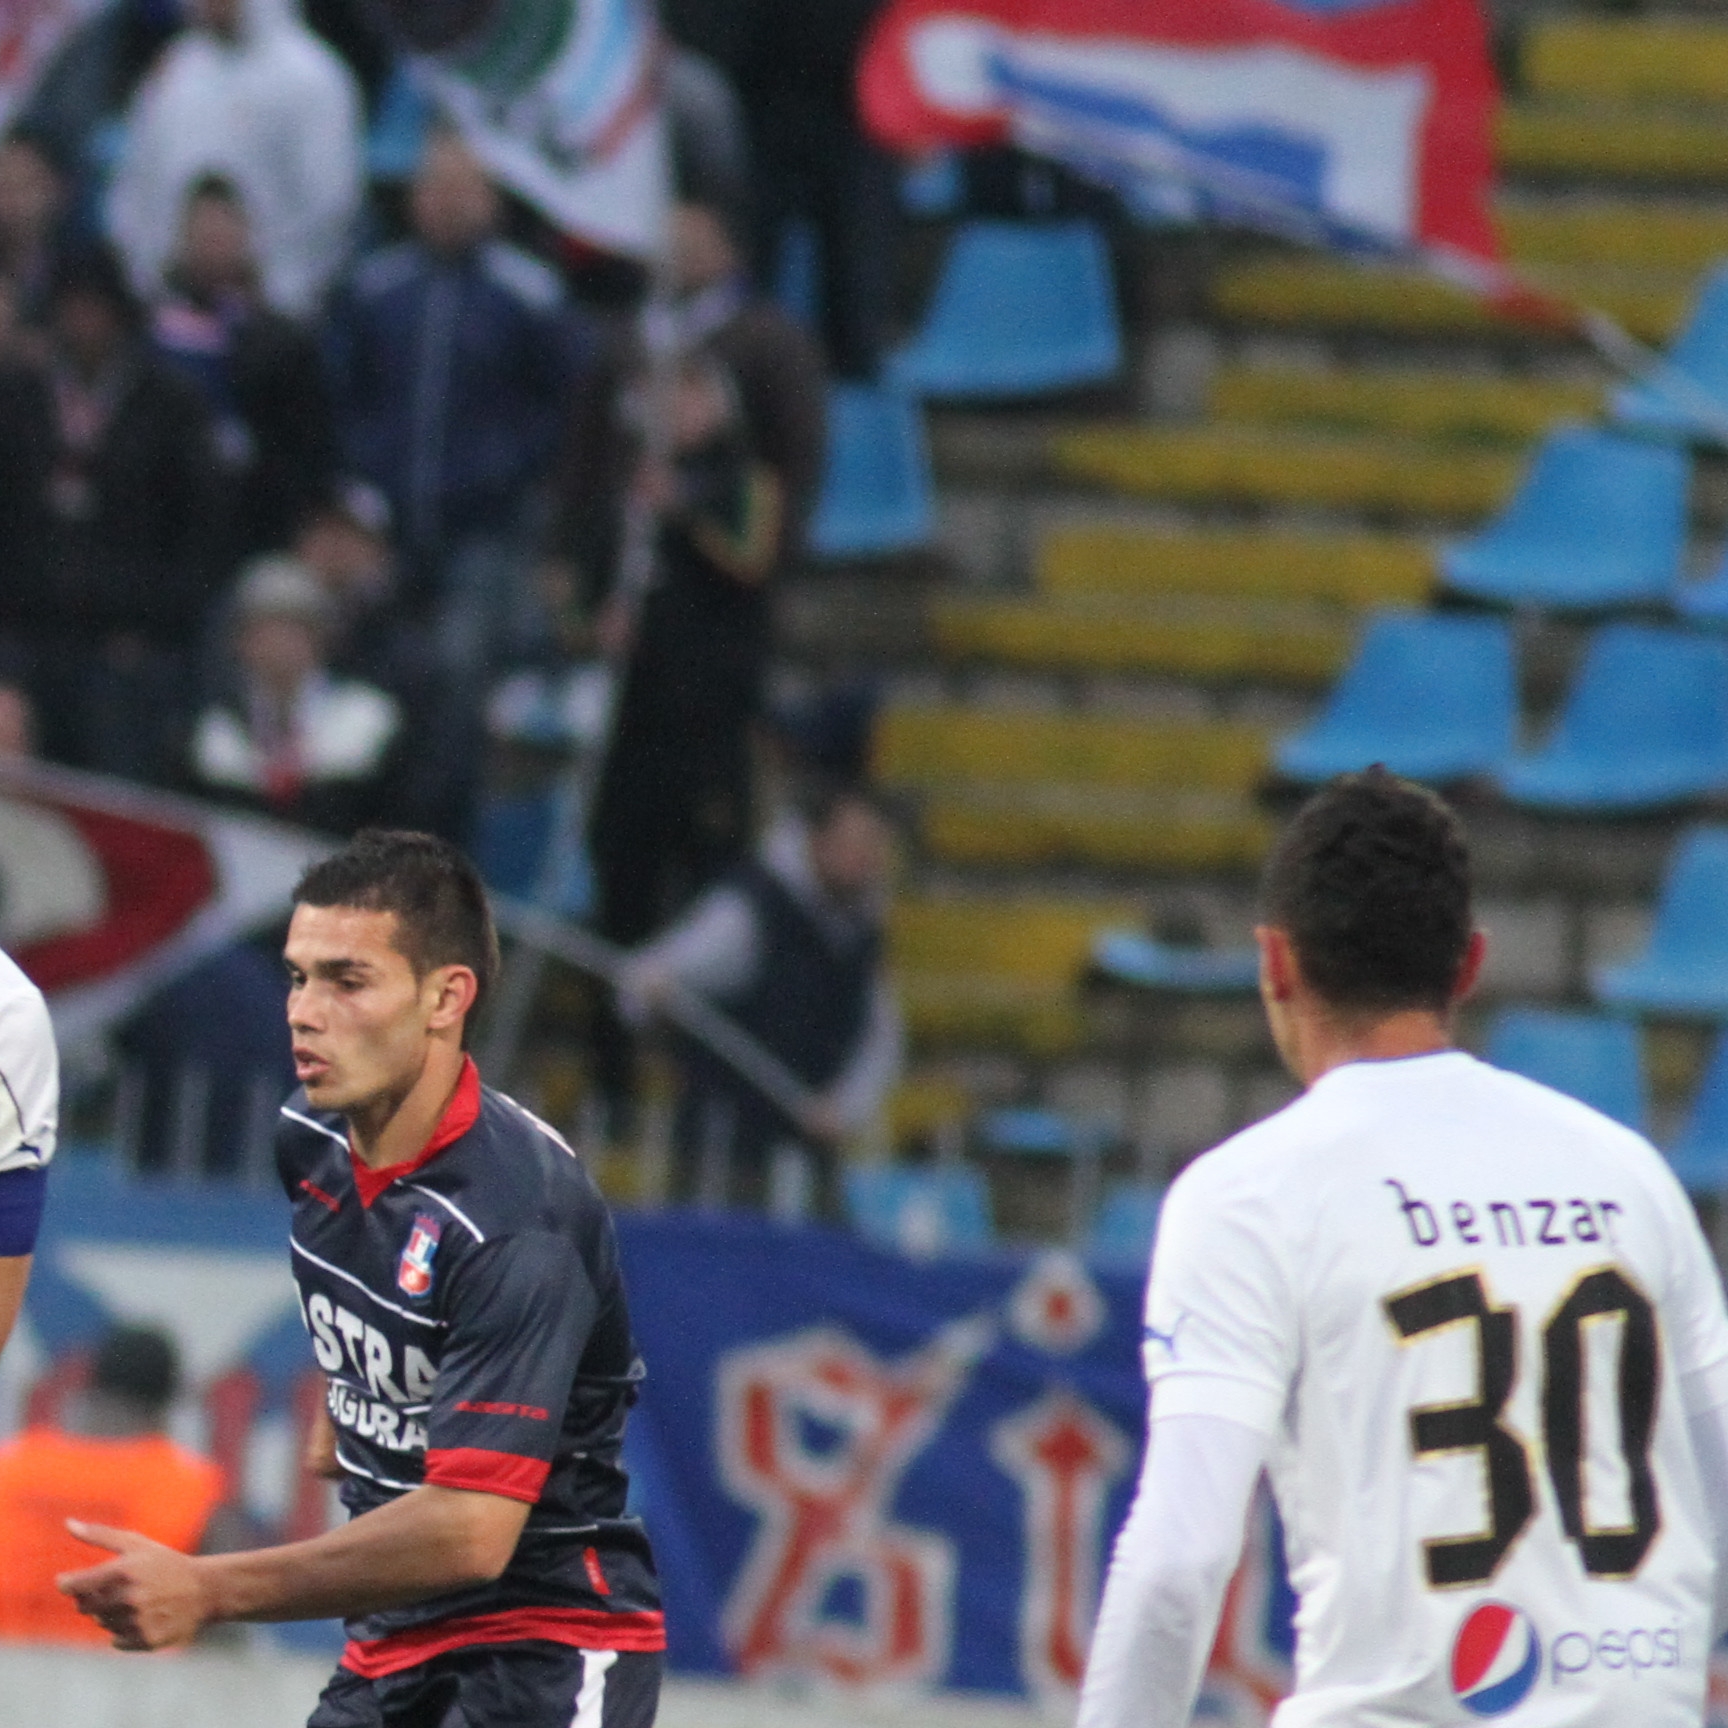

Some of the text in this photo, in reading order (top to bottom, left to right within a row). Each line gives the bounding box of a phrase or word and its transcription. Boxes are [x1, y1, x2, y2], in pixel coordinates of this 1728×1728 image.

[1384, 1178, 1622, 1247] benzar
[294, 1278, 440, 1404] STRA
[1382, 1263, 1664, 1592] 30
[1550, 1613, 1680, 1687] pepsi
